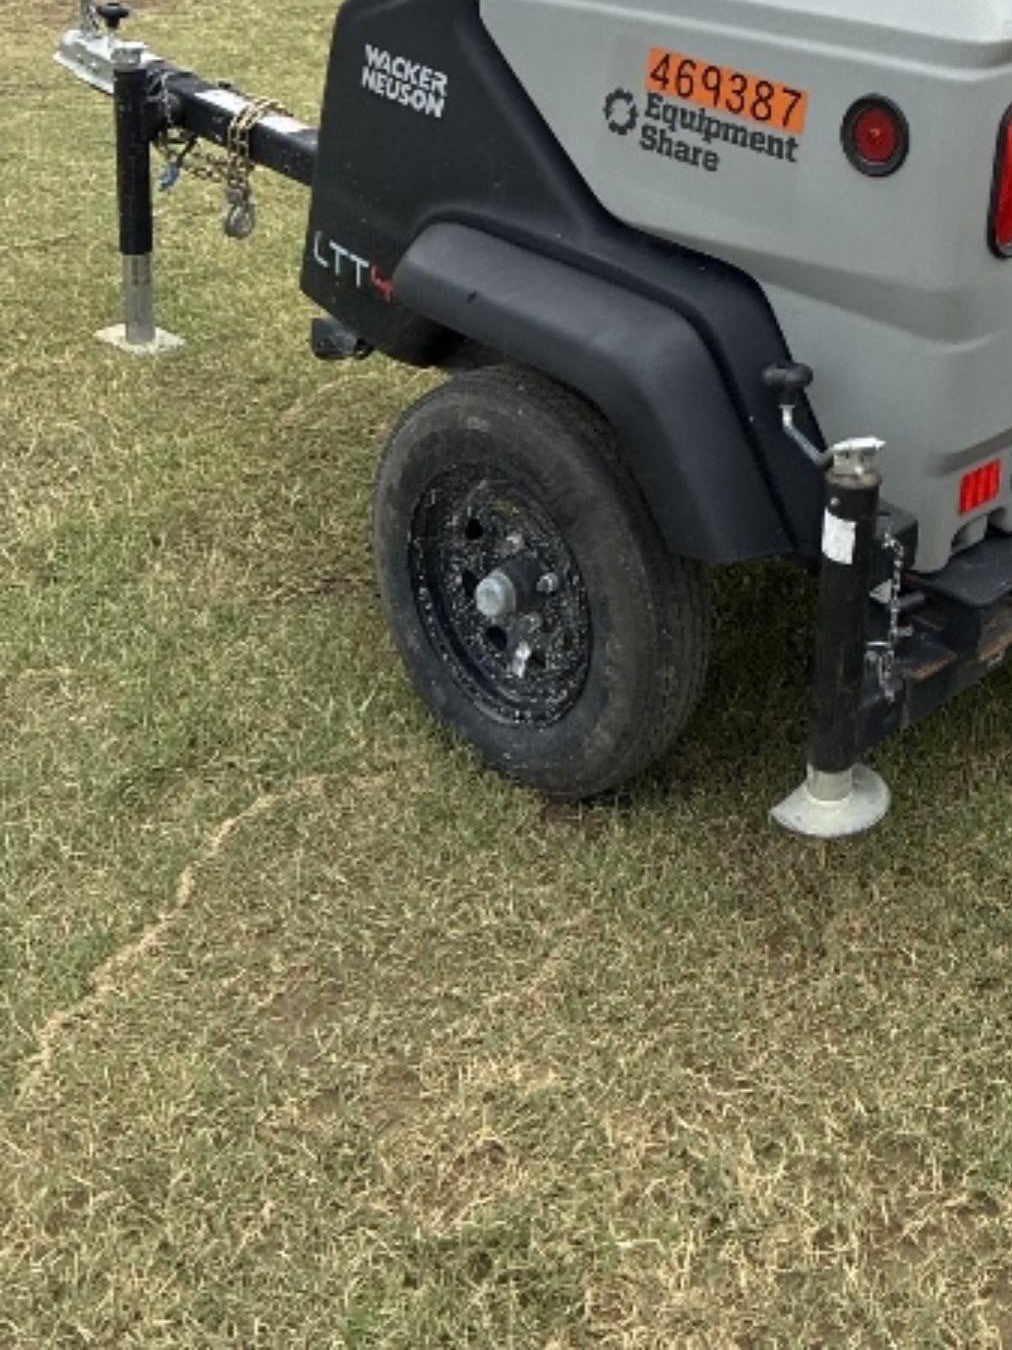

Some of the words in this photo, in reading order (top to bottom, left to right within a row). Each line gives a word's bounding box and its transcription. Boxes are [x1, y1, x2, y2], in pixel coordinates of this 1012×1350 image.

[362, 65, 445, 118] NEUSON
[364, 43, 448, 98] WACKER
[650, 53, 802, 127] 469387
[639, 124, 720, 172] Share
[645, 92, 800, 163] Equipment
